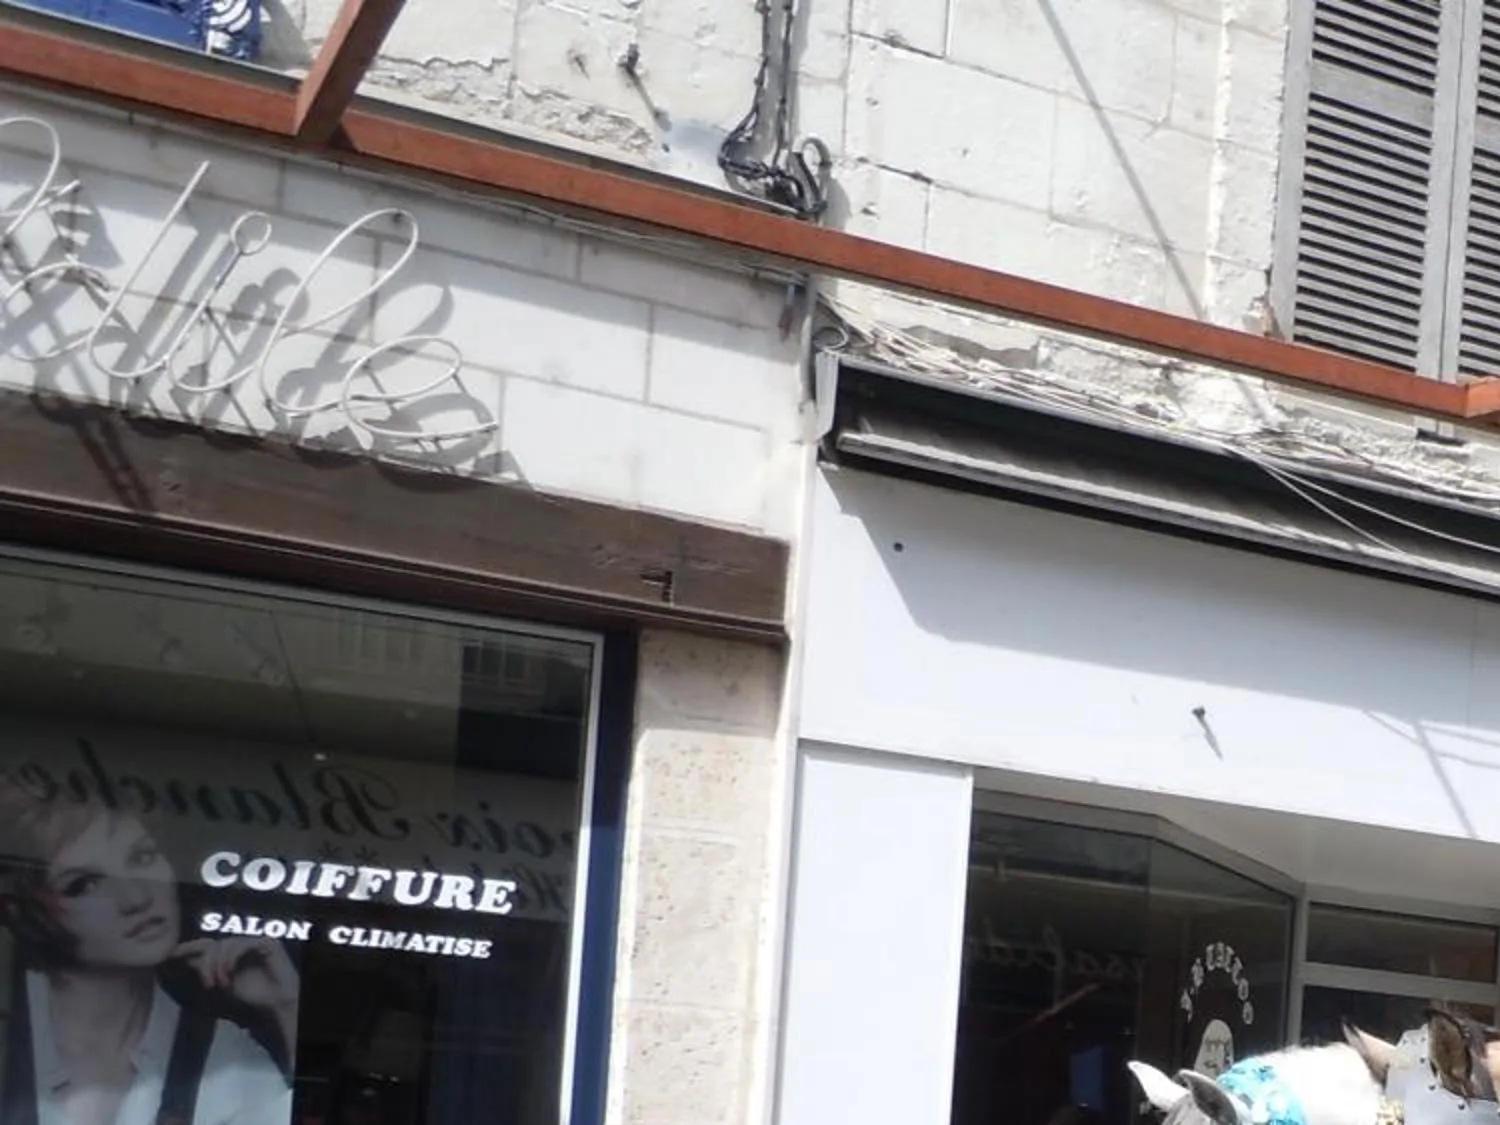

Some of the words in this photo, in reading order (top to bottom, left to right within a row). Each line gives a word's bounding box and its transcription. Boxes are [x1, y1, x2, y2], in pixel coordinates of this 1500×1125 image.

[200, 851, 516, 915] COIFFURE
[200, 911, 312, 942] SALON
[328, 925, 494, 959] CLIMATISE
